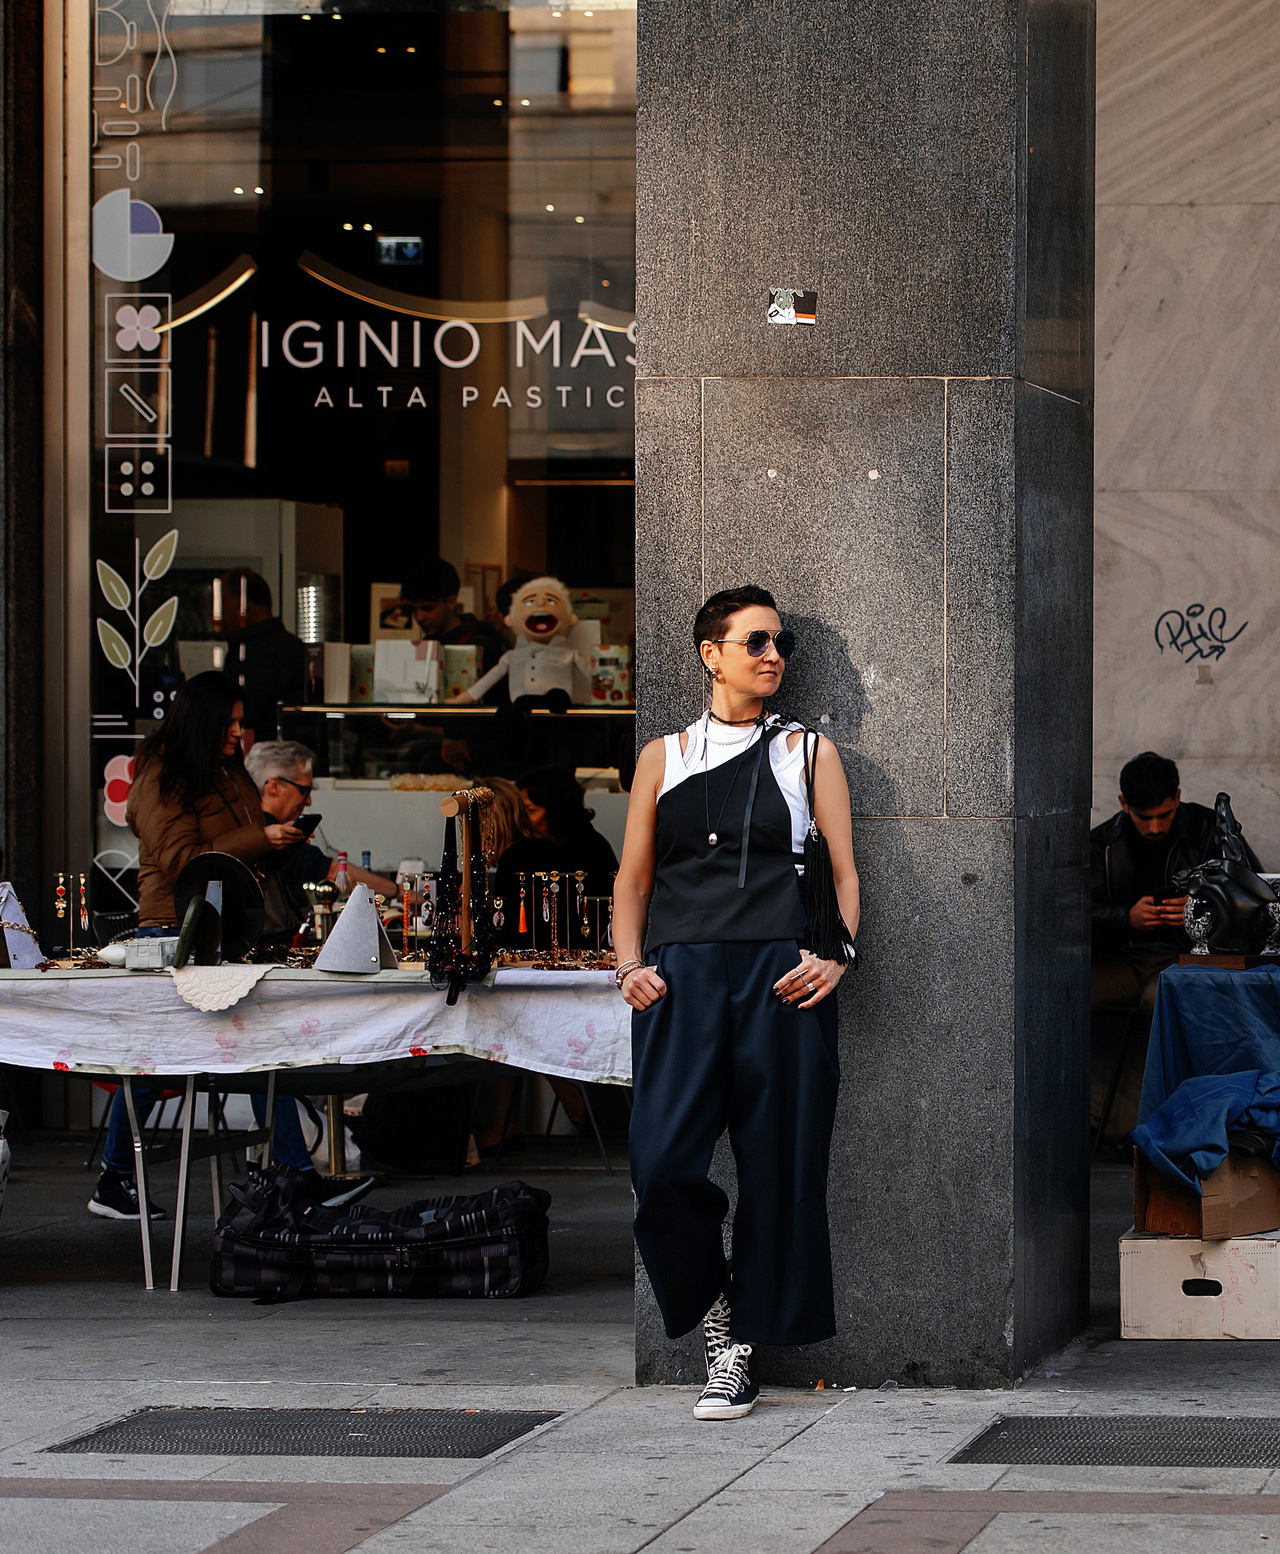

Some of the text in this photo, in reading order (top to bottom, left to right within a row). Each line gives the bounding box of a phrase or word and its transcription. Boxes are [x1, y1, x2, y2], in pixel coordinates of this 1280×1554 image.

[262, 320, 480, 368] IGINIO
[314, 386, 625, 408] ALTA PASTIC
